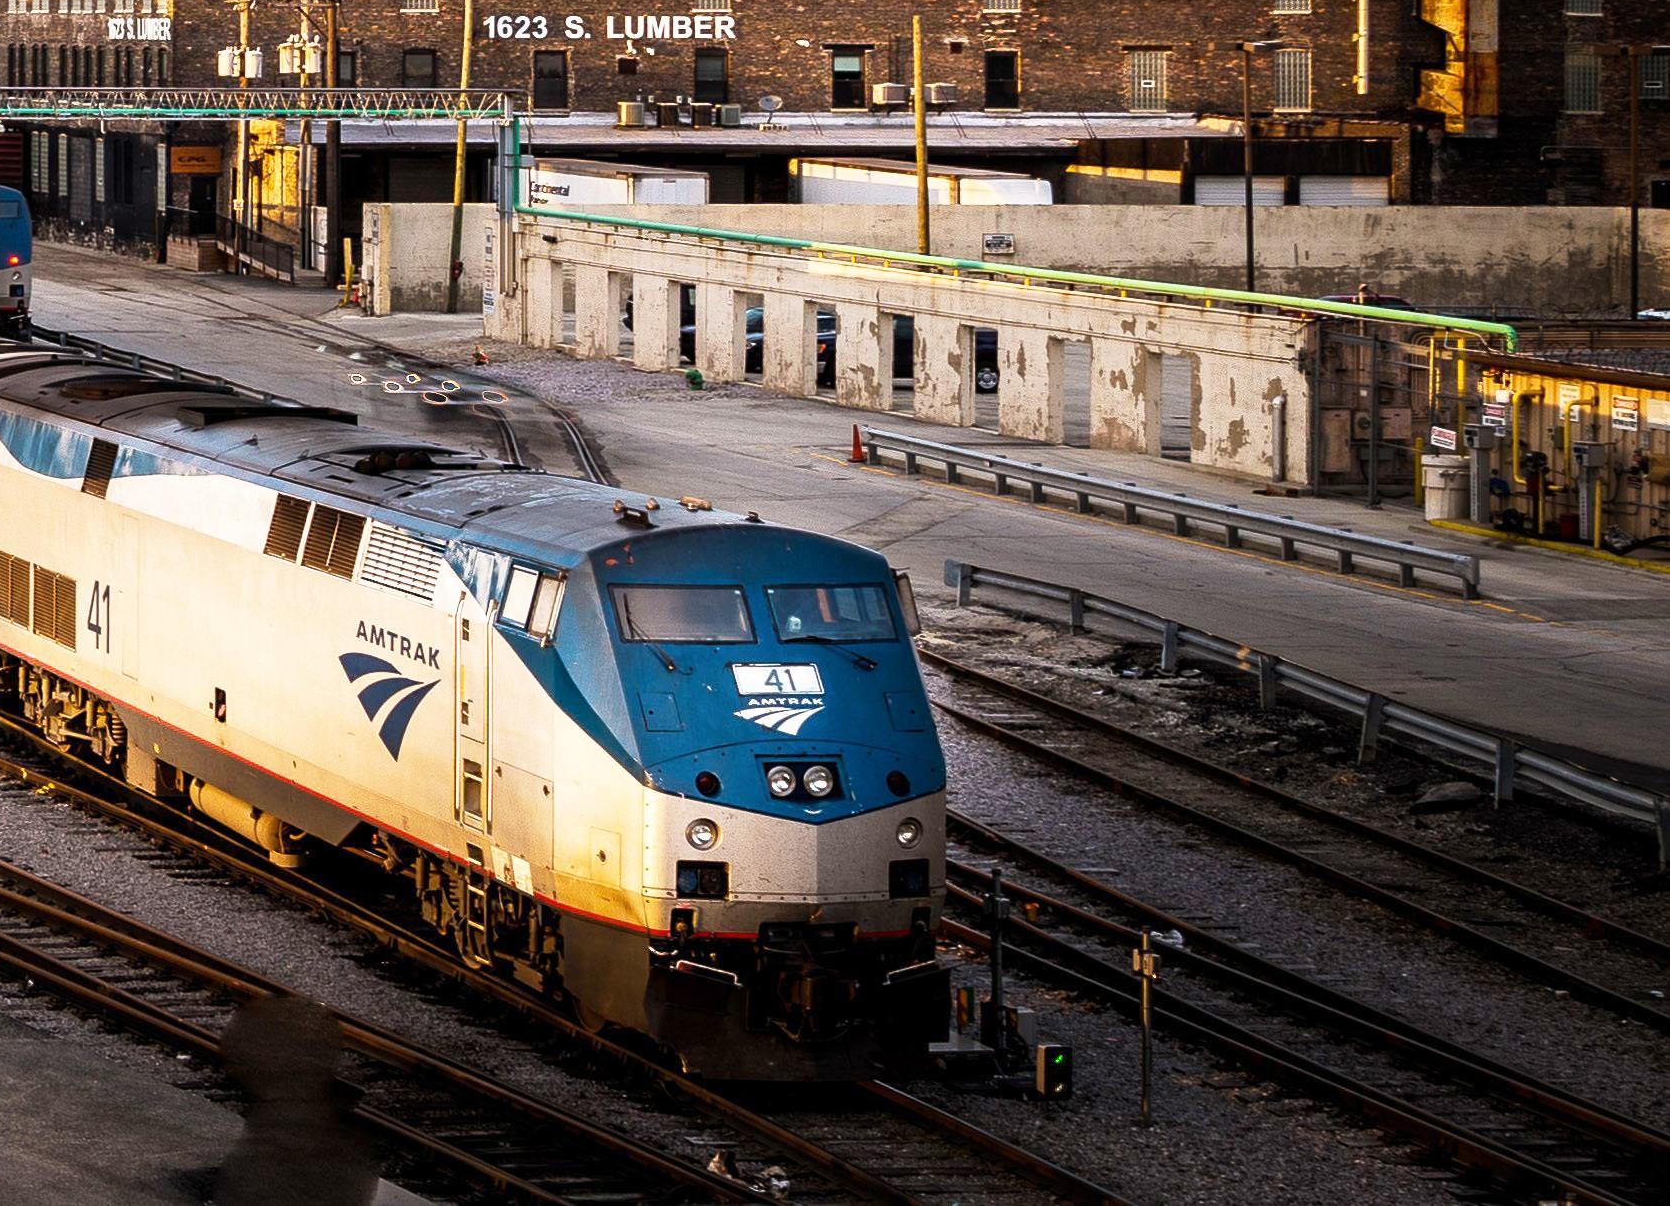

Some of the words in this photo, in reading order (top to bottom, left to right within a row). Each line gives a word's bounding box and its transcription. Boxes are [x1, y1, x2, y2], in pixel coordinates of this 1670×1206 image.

[137, 17, 172, 41] LUMBER
[483, 16, 549, 40] 1623
[564, 16, 592, 40] S.
[606, 16, 736, 40] LUMBER
[87, 579, 110, 654] 41
[355, 620, 441, 670] AMTRAK
[764, 669, 797, 692] 41
[747, 697, 824, 706] AMTRAK
